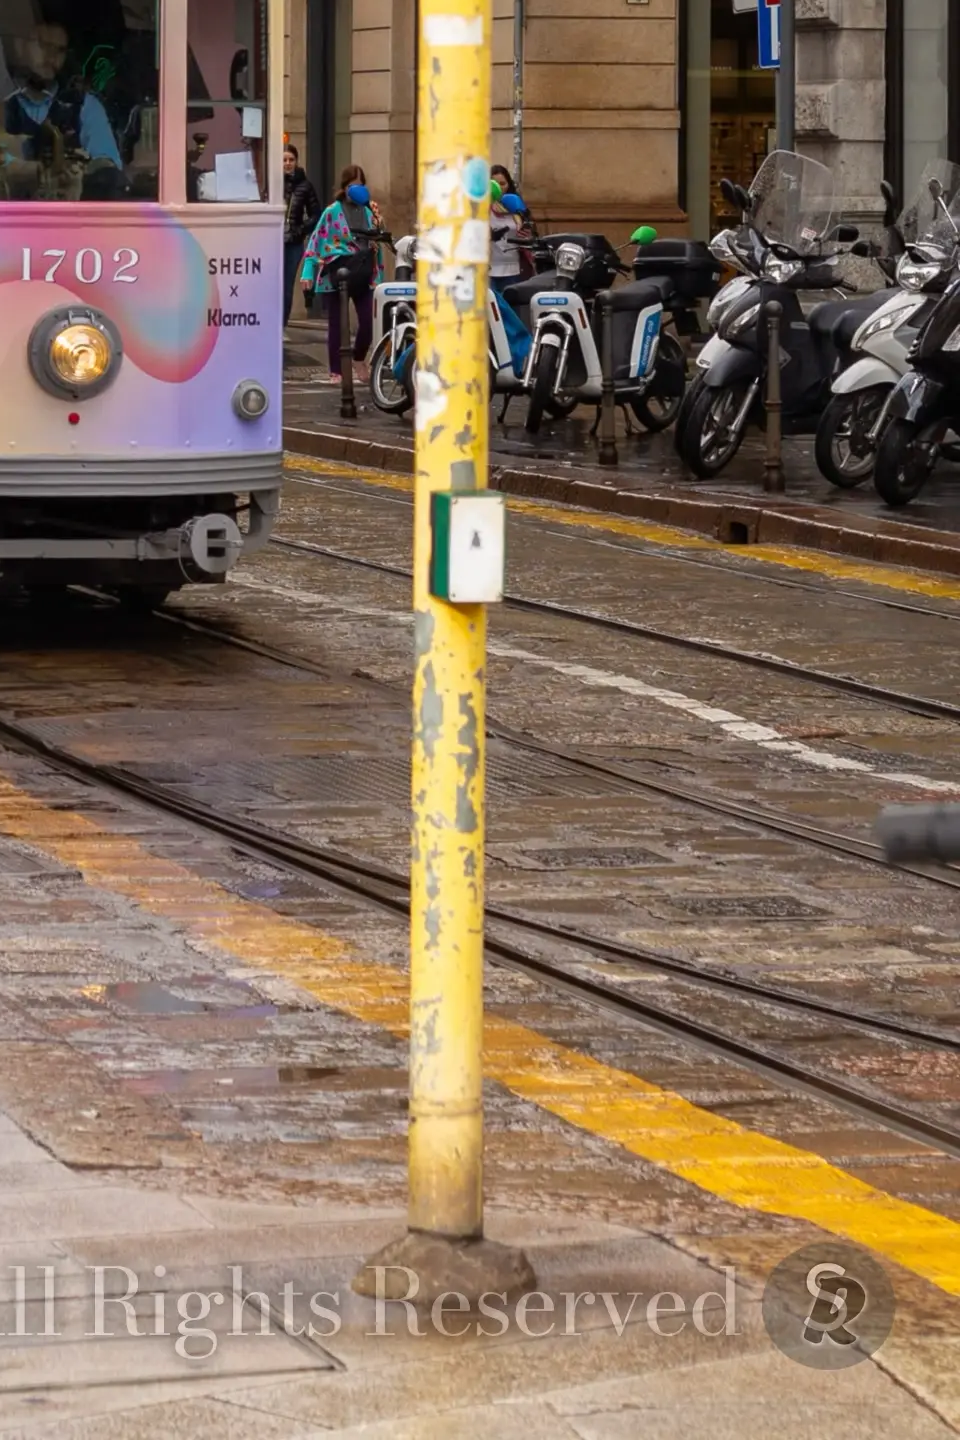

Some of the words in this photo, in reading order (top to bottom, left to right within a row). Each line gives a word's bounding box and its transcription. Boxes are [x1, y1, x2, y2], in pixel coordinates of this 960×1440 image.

[21, 246, 141, 284] 1702
[208, 258, 262, 276] SHEIN
[207, 308, 261, 328] Klarna.
